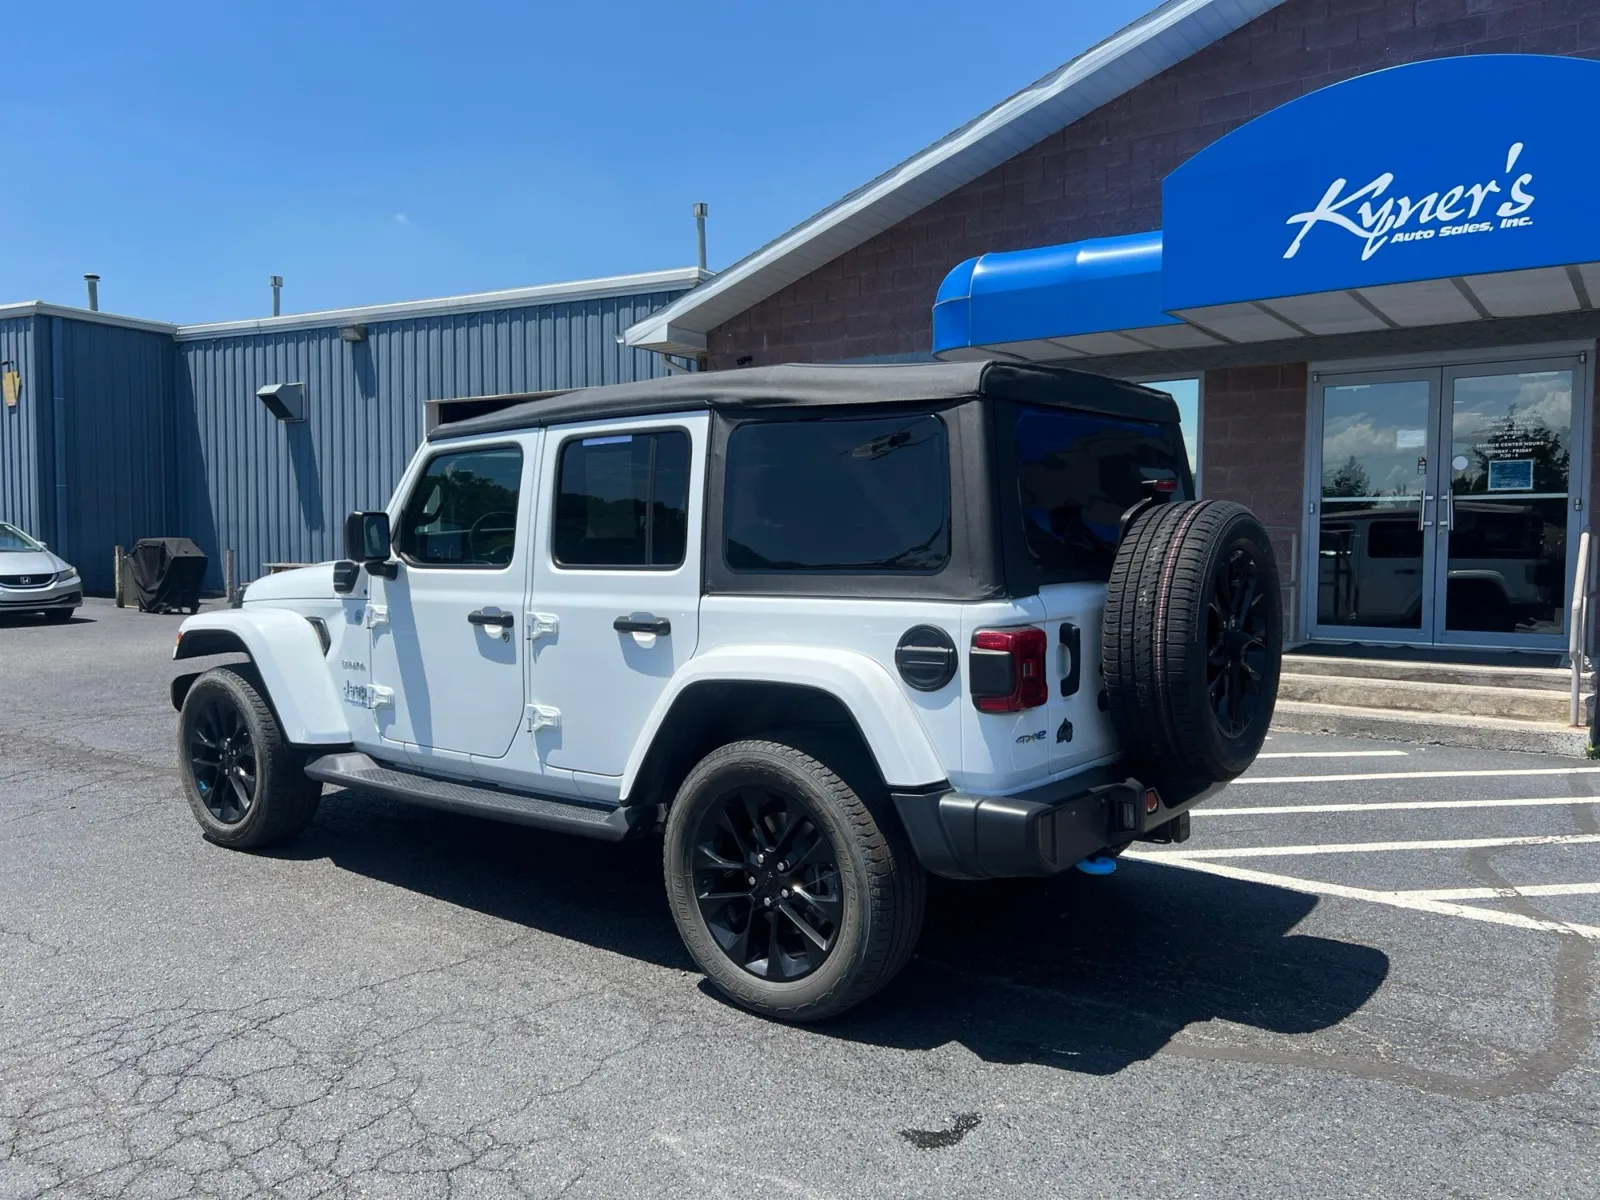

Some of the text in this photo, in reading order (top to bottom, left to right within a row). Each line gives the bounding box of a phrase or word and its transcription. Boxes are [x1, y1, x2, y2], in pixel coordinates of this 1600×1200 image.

[1282, 142, 1535, 262] Kyner's
[1390, 216, 1533, 243] Auto Sales, Inc.
